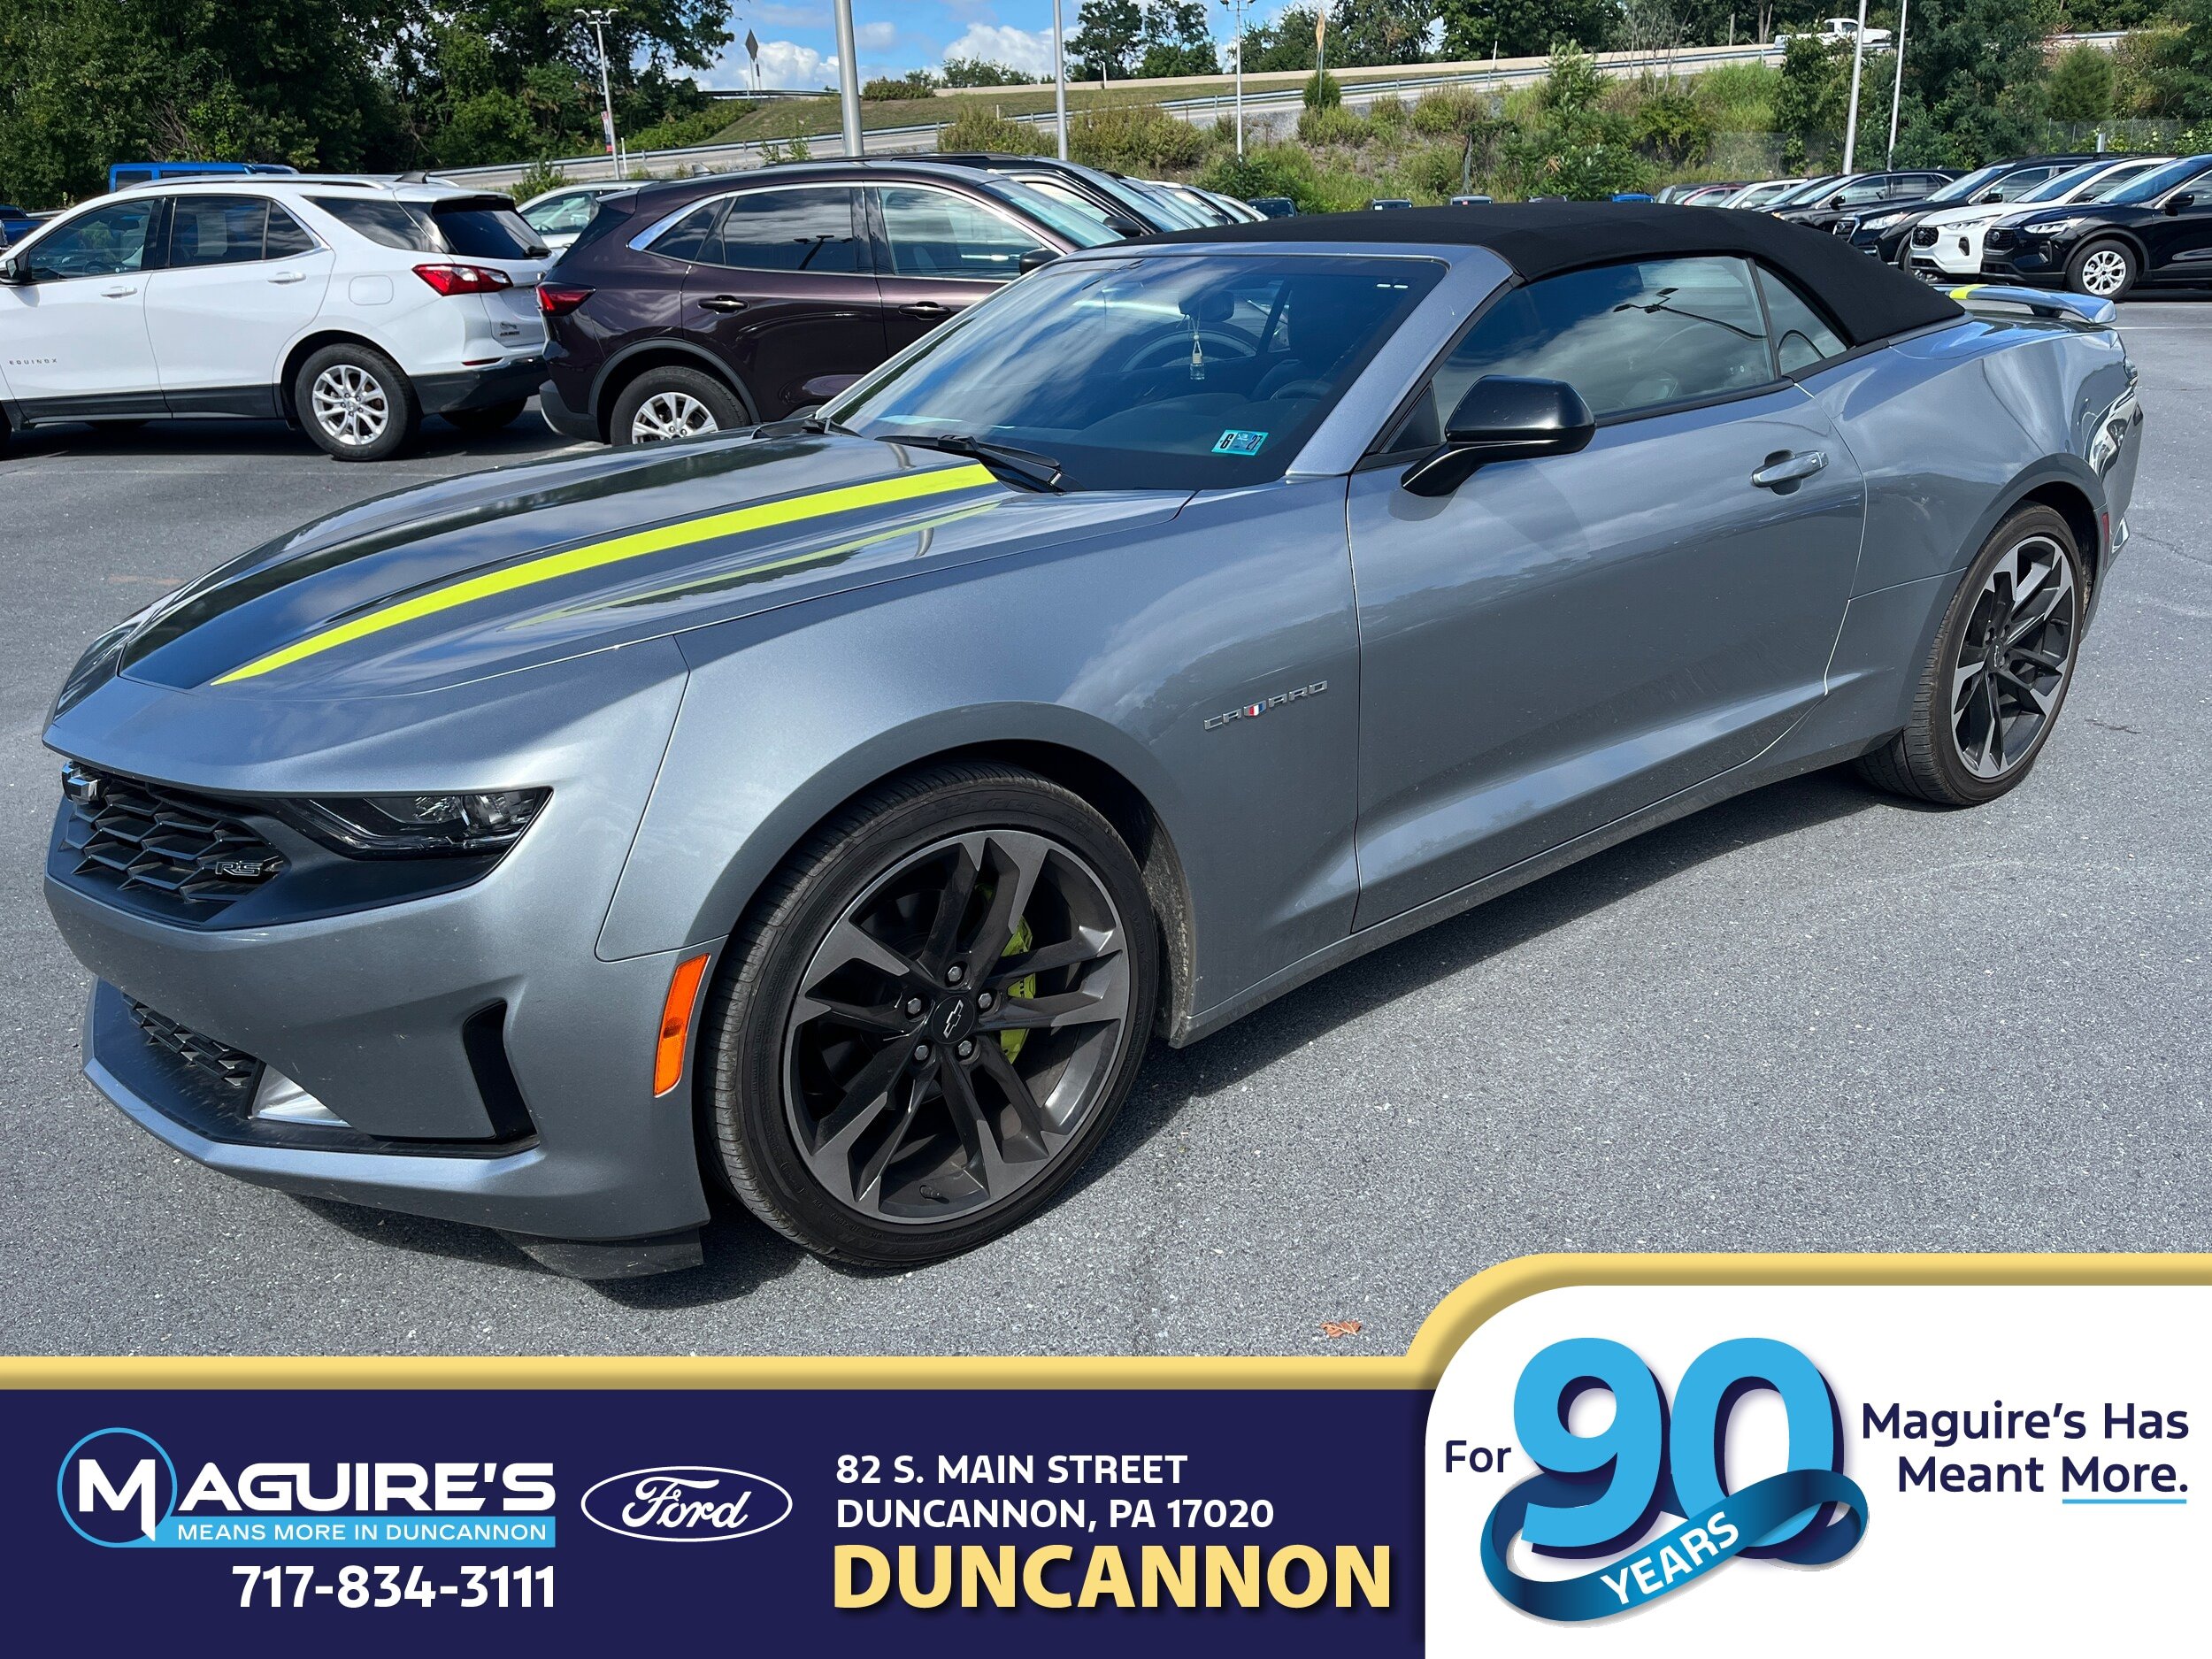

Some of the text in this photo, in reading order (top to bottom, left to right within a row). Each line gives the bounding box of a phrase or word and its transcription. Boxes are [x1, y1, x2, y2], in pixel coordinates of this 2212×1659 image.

[1219, 433, 1235, 449] 6
[1203, 680, 1328, 730] CAMARO
[215, 861, 263, 877] RS
